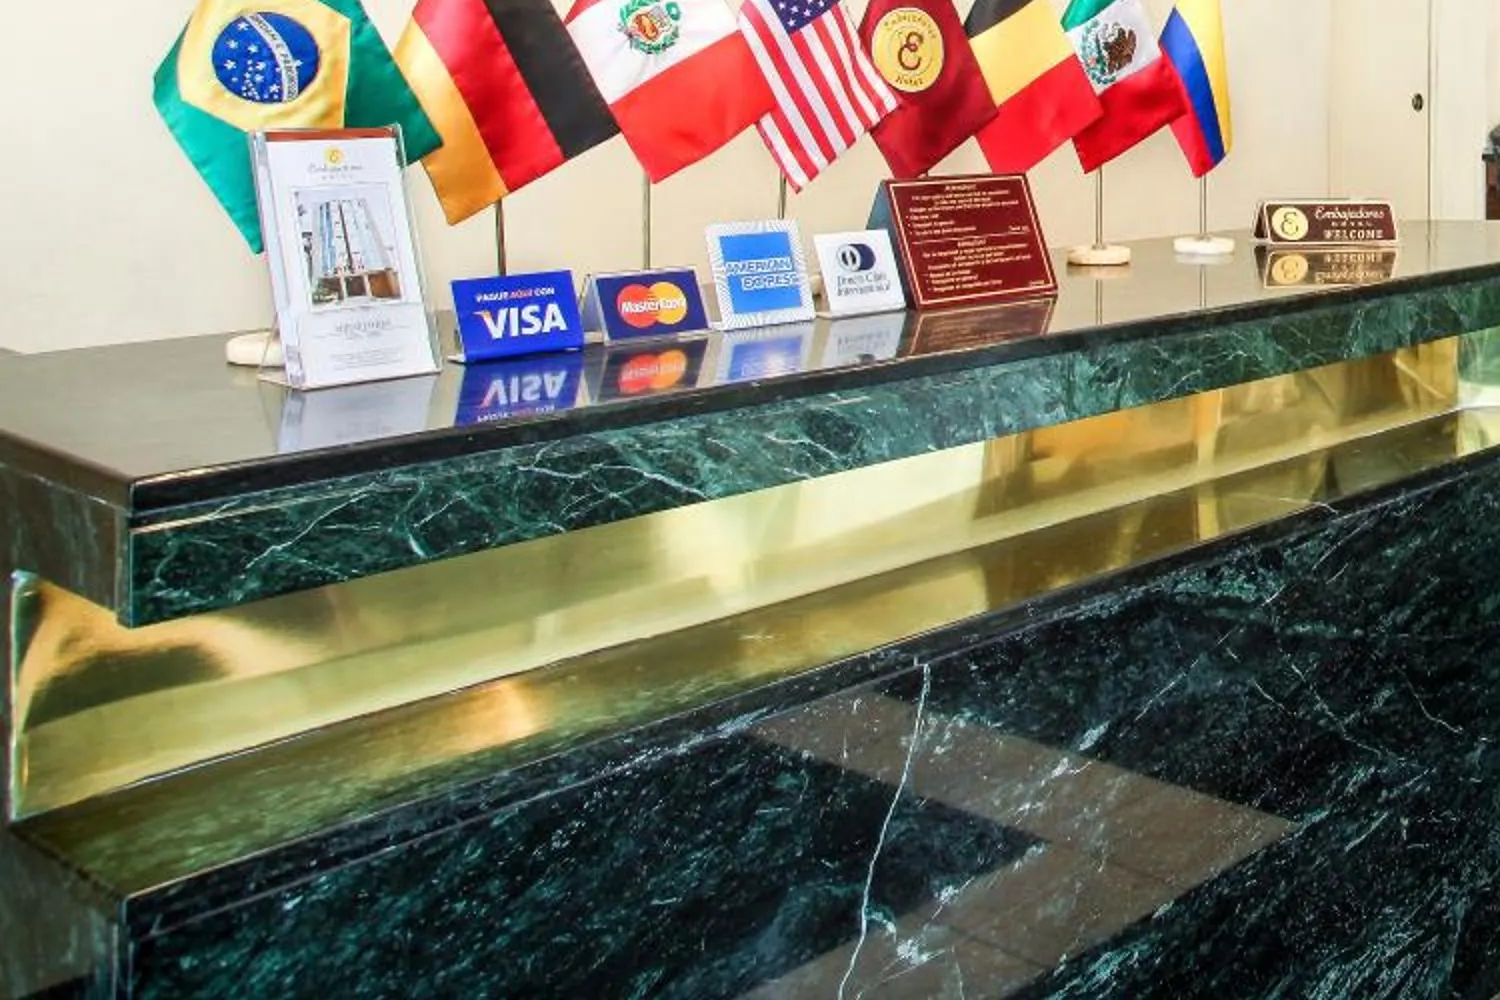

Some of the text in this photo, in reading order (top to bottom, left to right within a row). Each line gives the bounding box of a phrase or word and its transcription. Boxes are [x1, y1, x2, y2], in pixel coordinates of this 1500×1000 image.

[1323, 229, 1384, 239] WELCOME
[725, 257, 793, 275] AMERICAN
[475, 301, 568, 340] VISA
